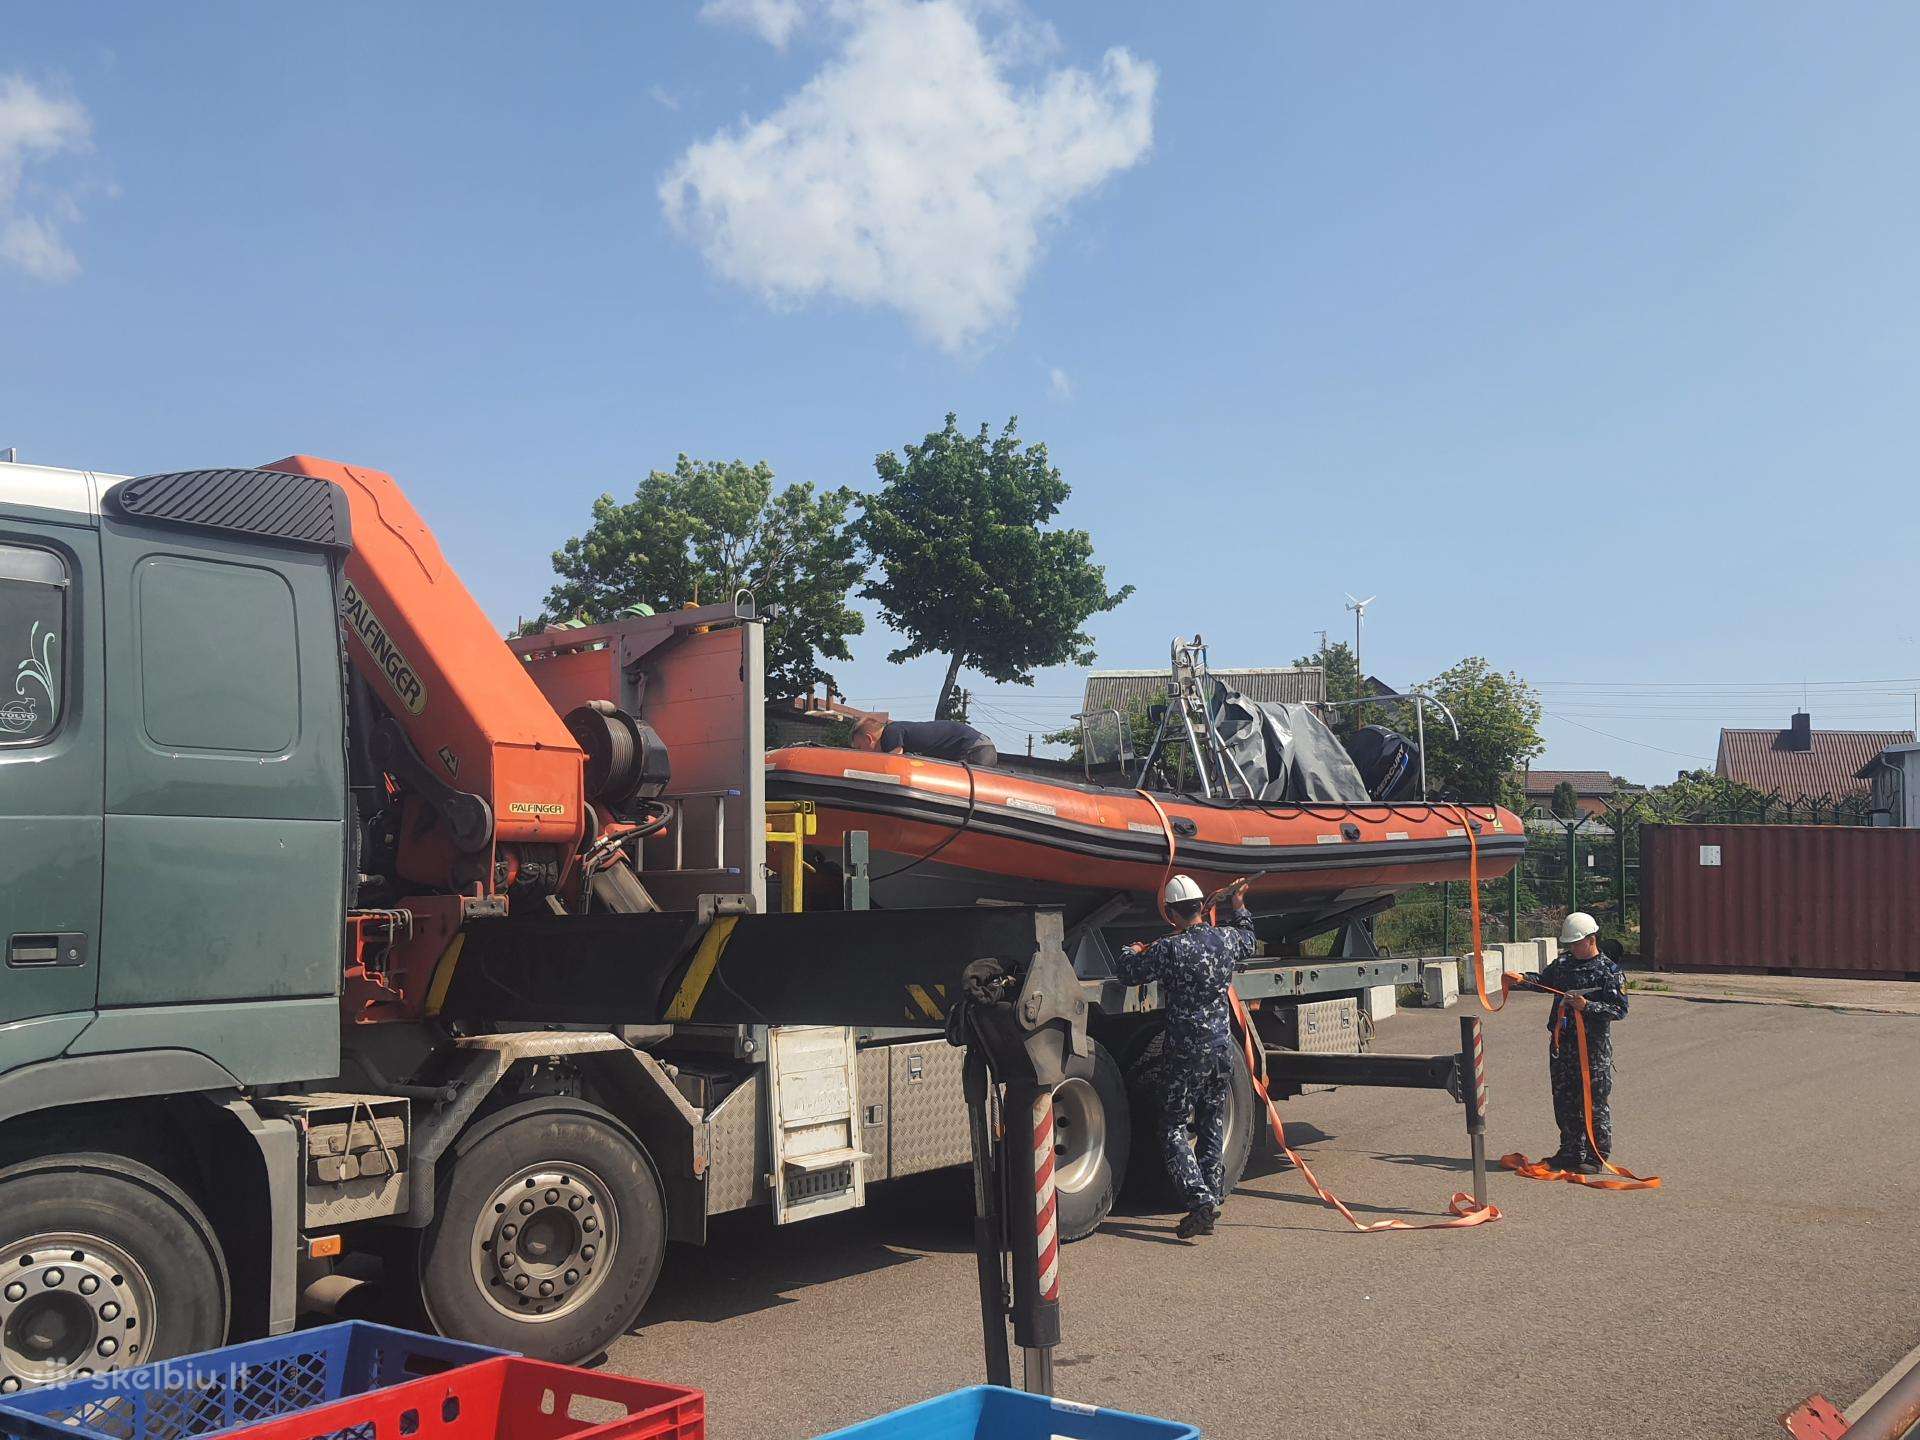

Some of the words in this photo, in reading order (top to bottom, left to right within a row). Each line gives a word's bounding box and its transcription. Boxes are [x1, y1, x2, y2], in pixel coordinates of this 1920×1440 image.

[345, 585, 421, 707] PALFINGER
[0, 712, 35, 720] VOLVO
[511, 803, 563, 814] PALFINGER
